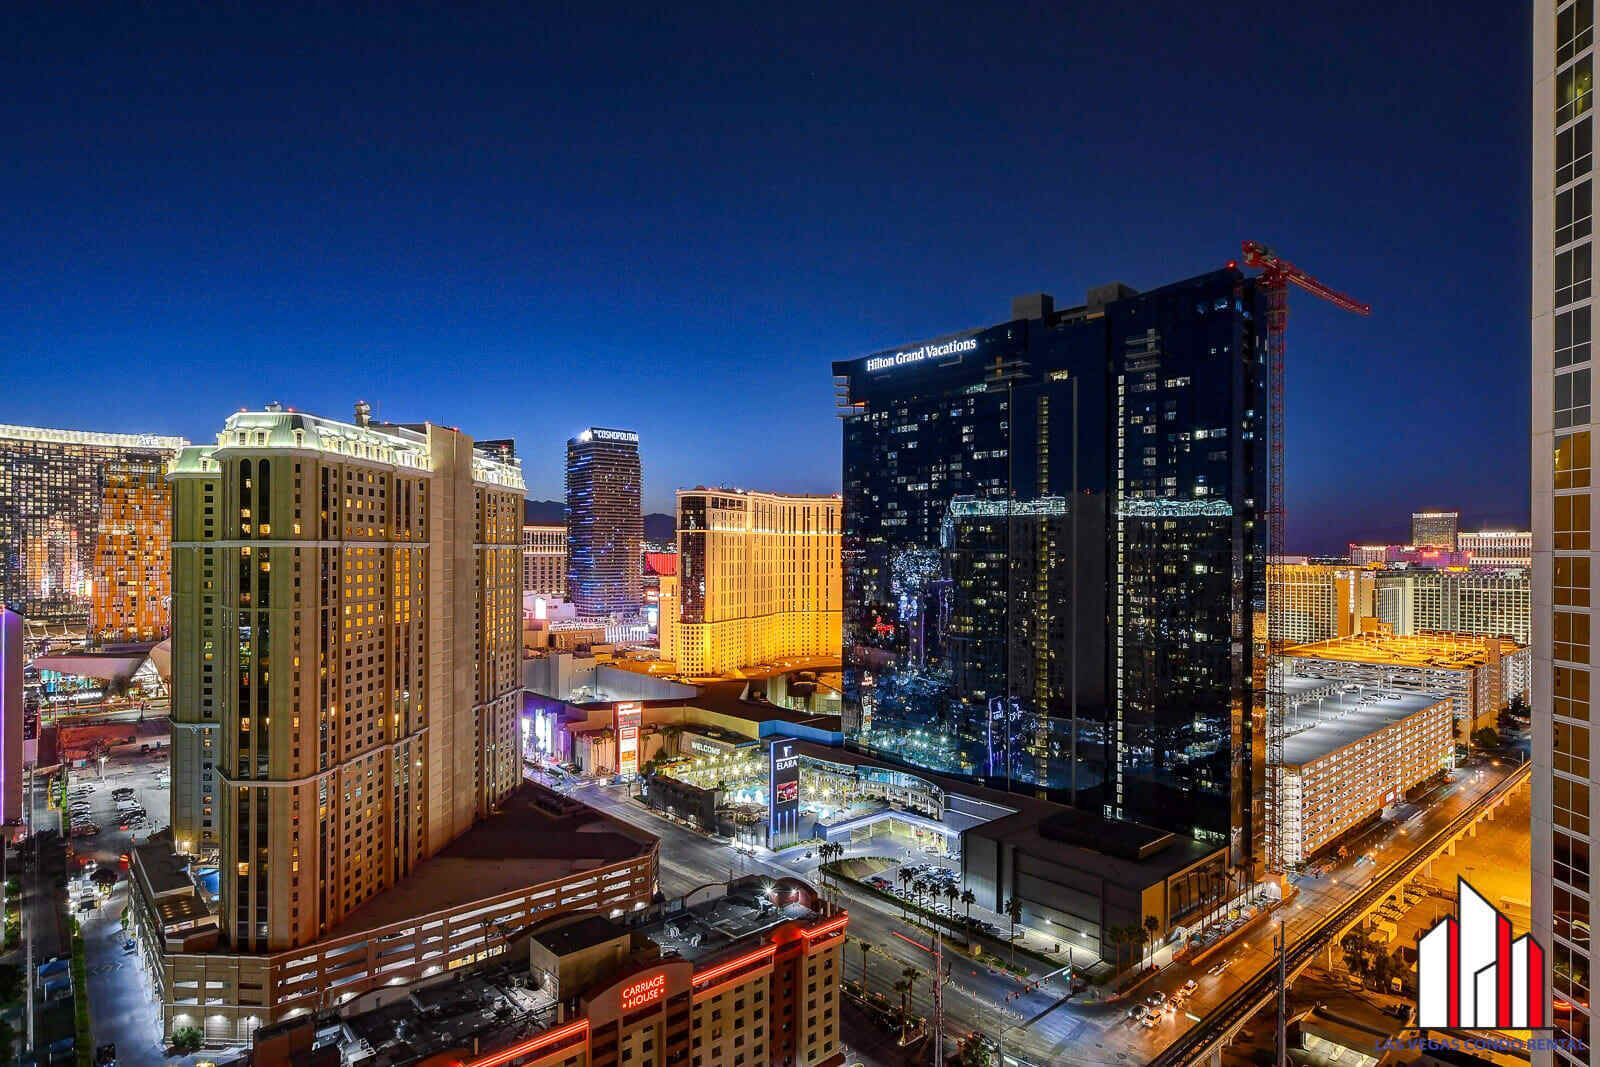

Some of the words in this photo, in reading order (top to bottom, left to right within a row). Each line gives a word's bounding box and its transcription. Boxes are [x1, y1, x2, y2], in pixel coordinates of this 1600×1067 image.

[867, 357, 895, 371] Hilton
[895, 347, 925, 364] Grand
[925, 339, 976, 358] Vacations
[597, 430, 639, 441] COSMOPOLITAN
[691, 741, 720, 756] WELCOME
[776, 760, 798, 771] ELARA
[623, 975, 664, 999] CARRIAGE
[628, 988, 658, 1008] HOUSE
